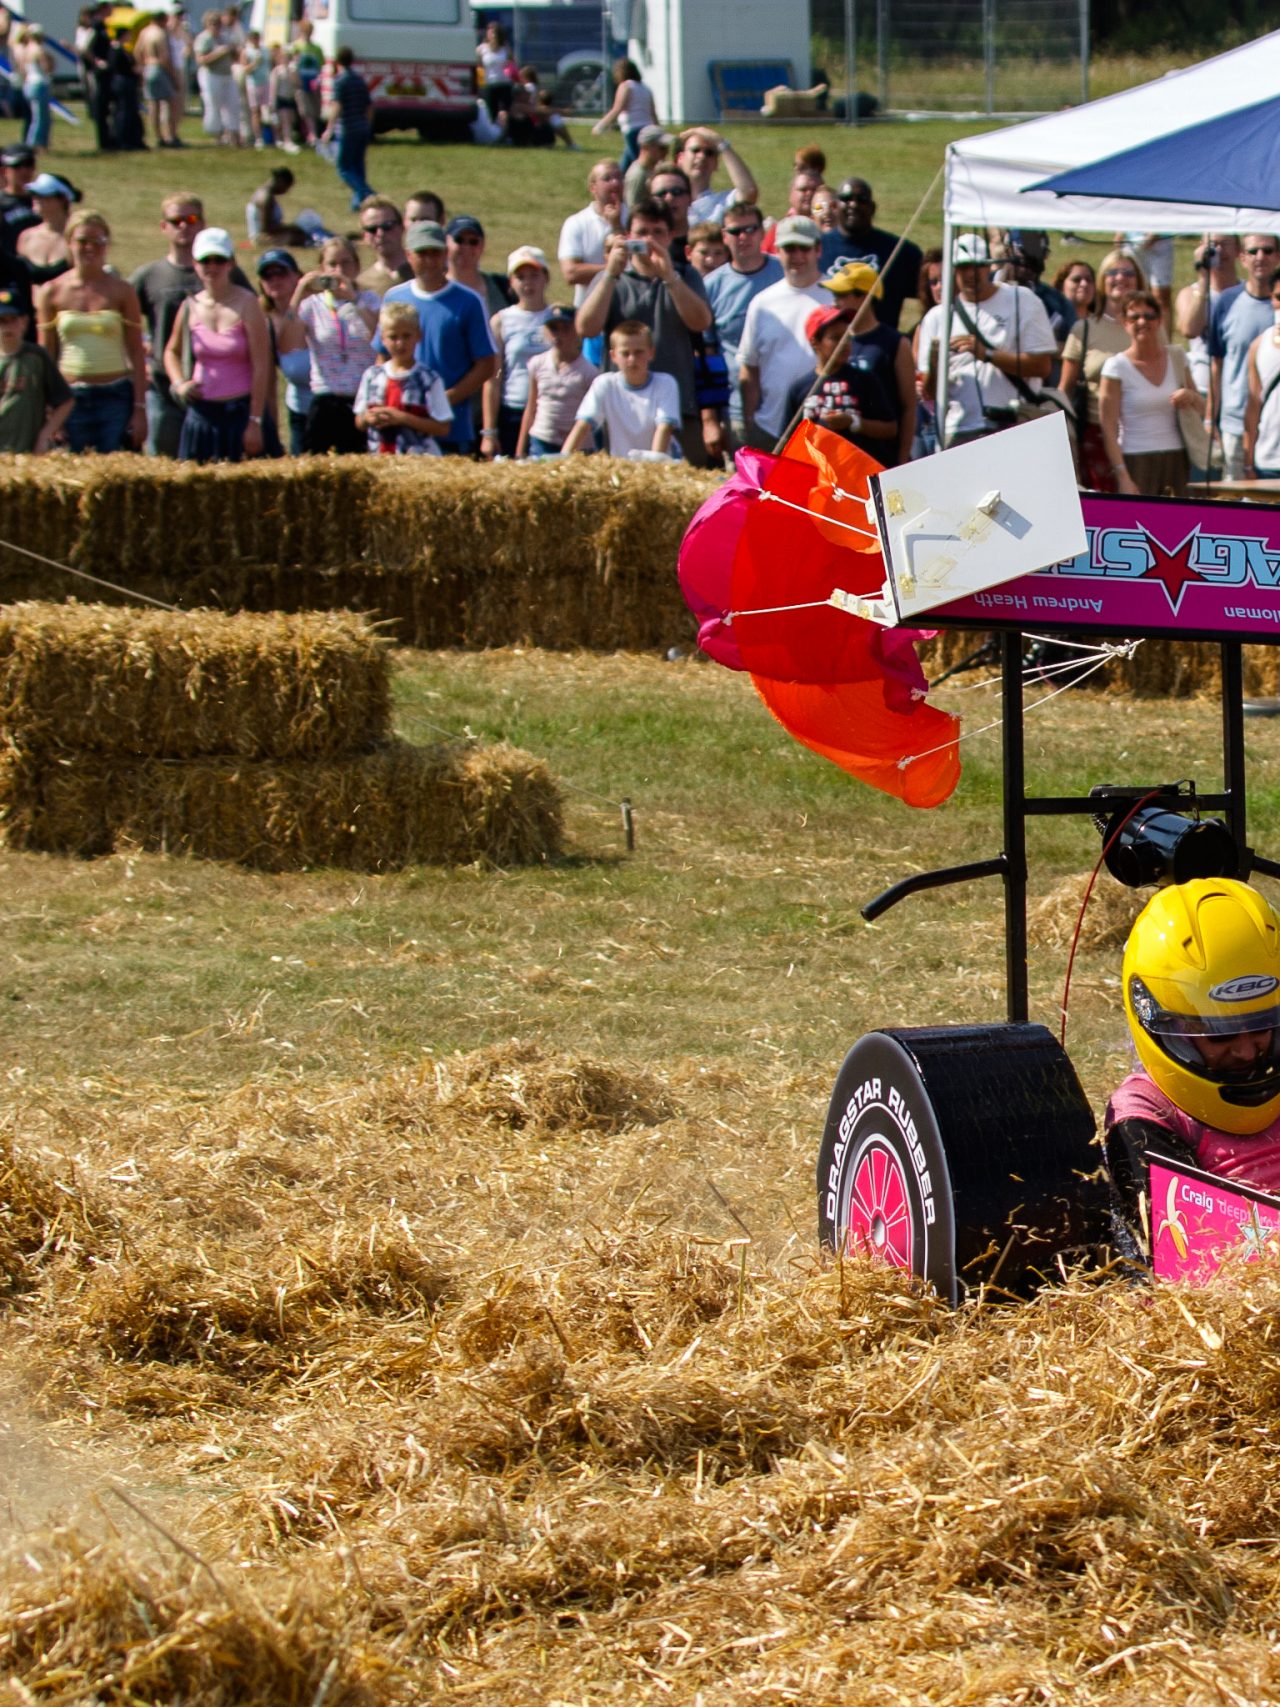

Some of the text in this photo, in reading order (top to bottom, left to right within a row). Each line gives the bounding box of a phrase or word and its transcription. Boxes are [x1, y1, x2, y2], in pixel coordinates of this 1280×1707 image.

[974, 593, 1103, 613] Andrew Heath
[1215, 977, 1275, 996] KBC
[826, 1077, 936, 1225] DRAGSTAR RUBBER
[1181, 1184, 1214, 1213] Craig
